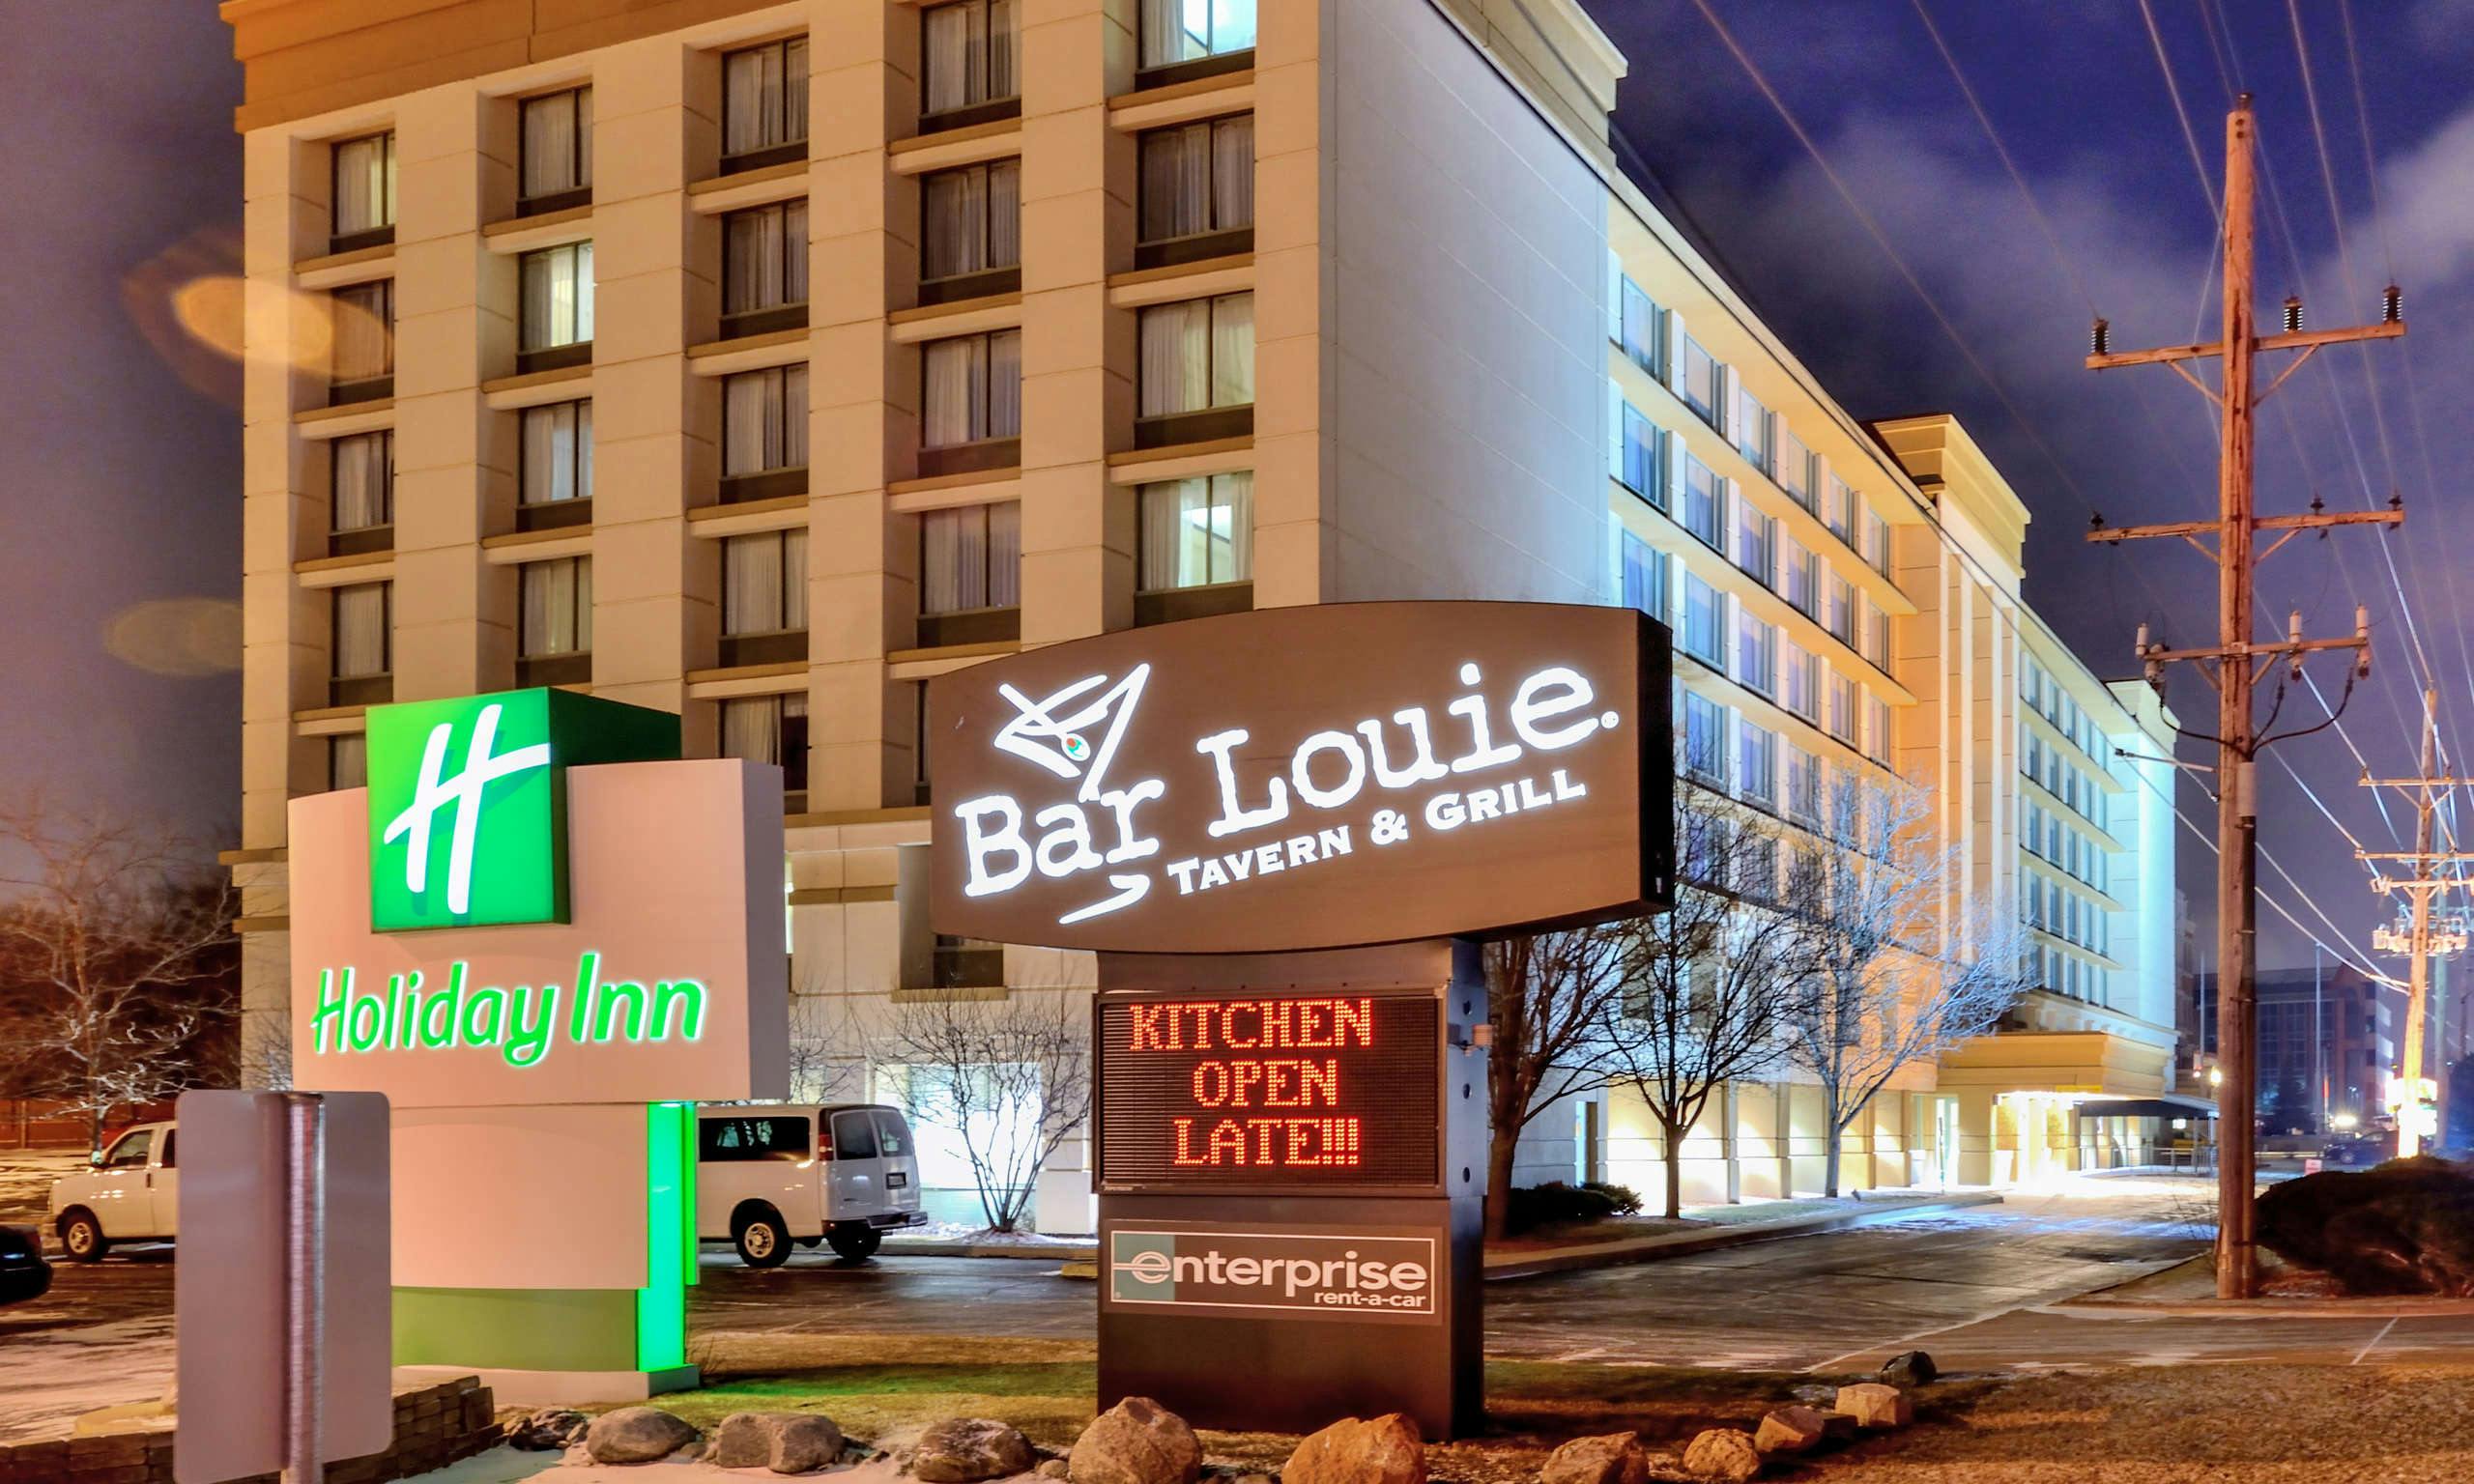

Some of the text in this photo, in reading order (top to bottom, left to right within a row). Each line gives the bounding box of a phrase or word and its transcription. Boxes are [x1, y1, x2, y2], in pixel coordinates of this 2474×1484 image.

[954, 778, 1165, 898] Bar
[1167, 770, 1588, 896] TAVERN & GRILL
[310, 951, 708, 1068] Holiday Inn
[1129, 998, 1373, 1051] KITCHEN
[1193, 1060, 1338, 1108] OPEN
[1173, 1119, 1361, 1166] LATE!!!
[1131, 1250, 1427, 1298] enterprise
[1313, 1290, 1427, 1309] rent-a-car
